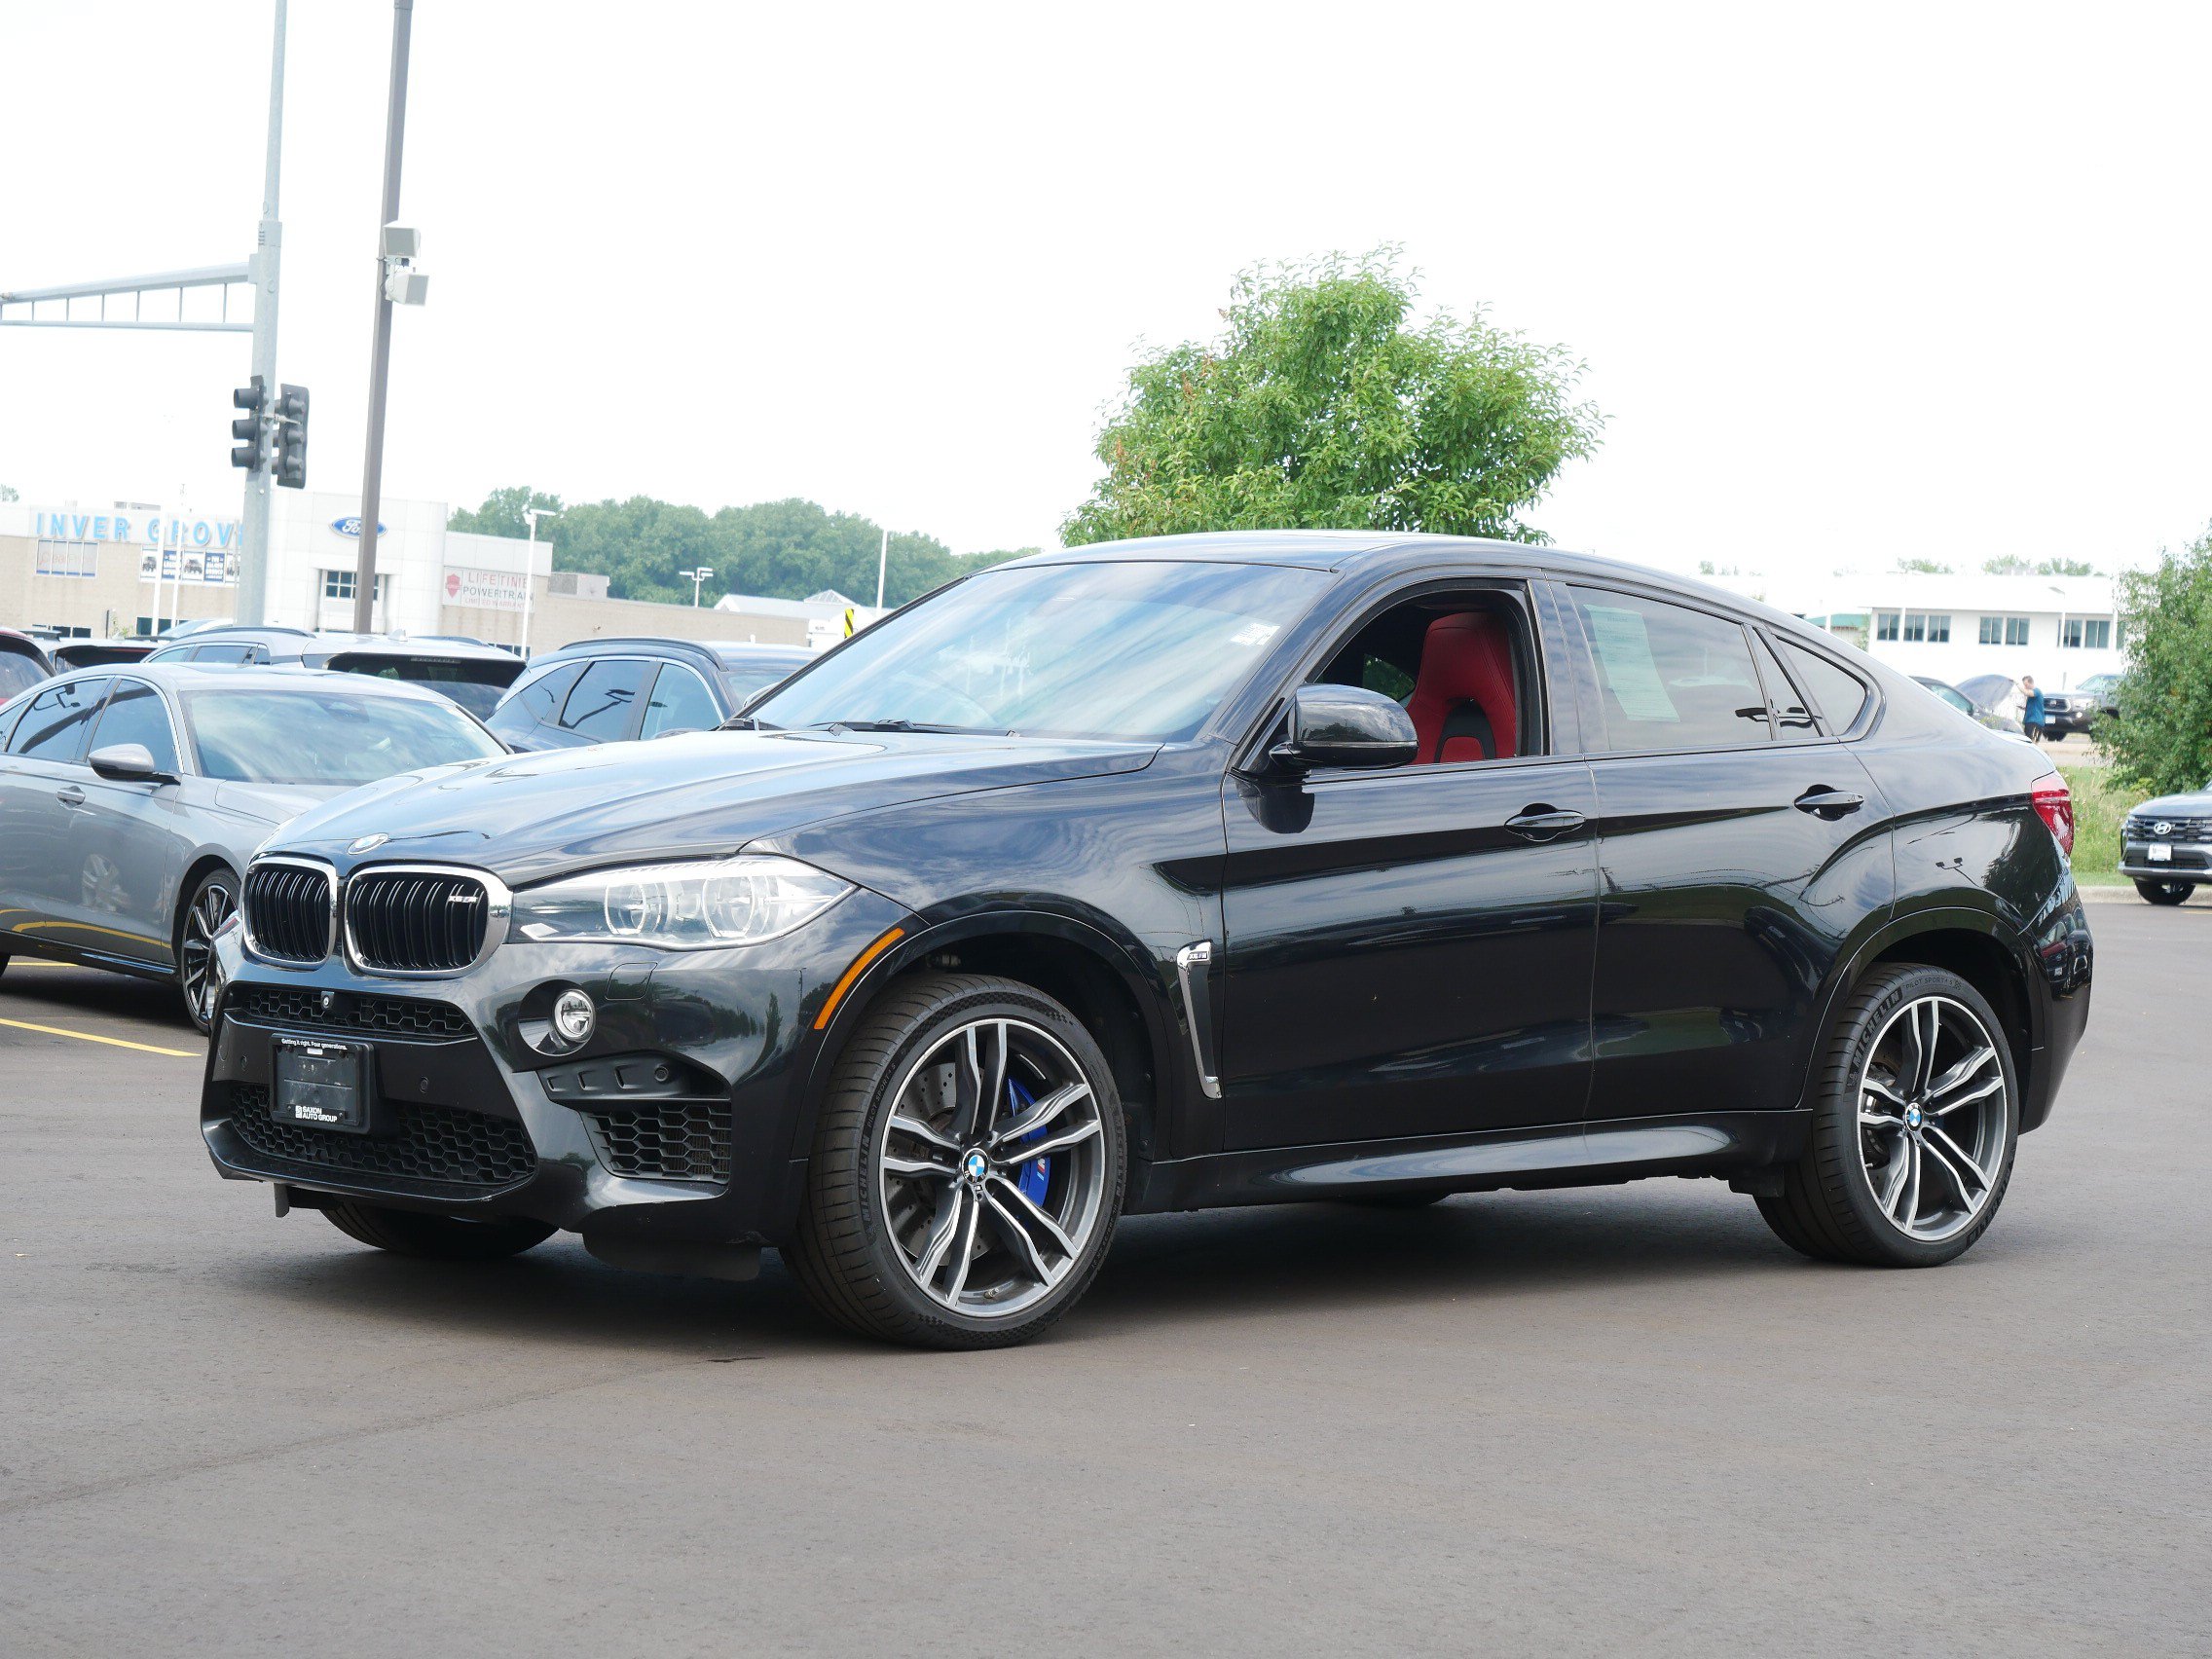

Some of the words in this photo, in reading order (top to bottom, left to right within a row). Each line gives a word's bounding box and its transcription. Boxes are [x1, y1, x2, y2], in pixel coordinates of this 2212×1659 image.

[36, 512, 129, 540] INVER
[468, 571, 527, 588] LIFETIME
[492, 600, 526, 609] WARRANT
[1852, 988, 1902, 1068] MICHELIN
[302, 1105, 322, 1114] SAXON
[317, 1114, 338, 1123] GROUP
[858, 1134, 872, 1222] MICHELIN
[866, 1104, 878, 1127] PILOT
